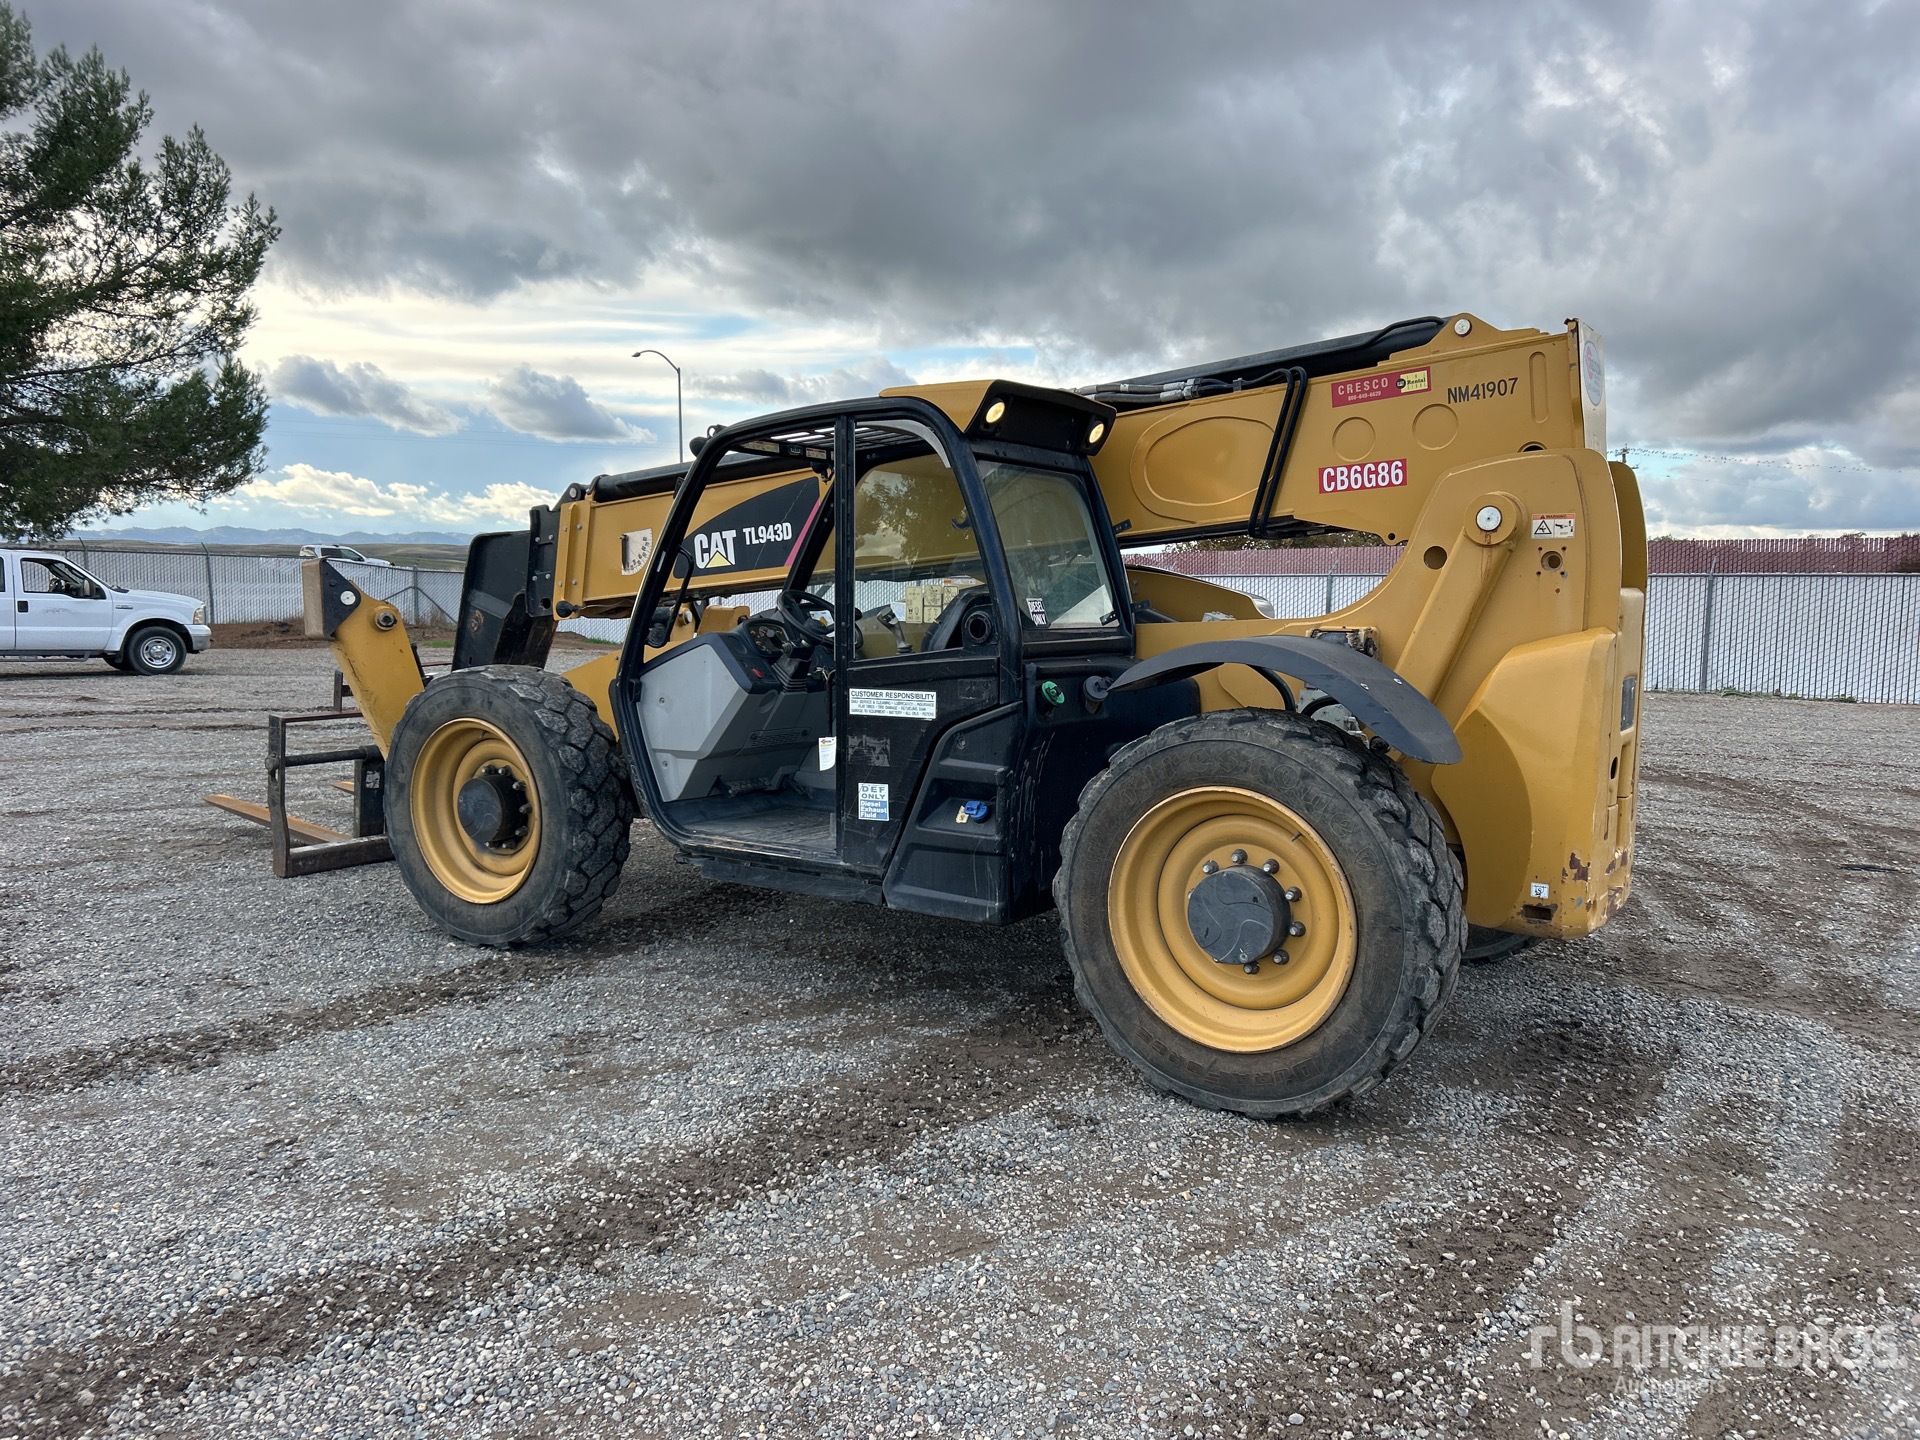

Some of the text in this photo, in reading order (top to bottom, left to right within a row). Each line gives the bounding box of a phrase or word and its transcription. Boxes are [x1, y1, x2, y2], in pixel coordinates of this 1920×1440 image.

[1338, 378, 1388, 395] CRESCO
[1447, 377, 1519, 404] NM41907
[1323, 461, 1403, 492] CB6G86
[694, 522, 792, 569] CAT TL943D
[885, 692, 934, 700] RESPONSIBILITY
[861, 785, 886, 793] DEF
